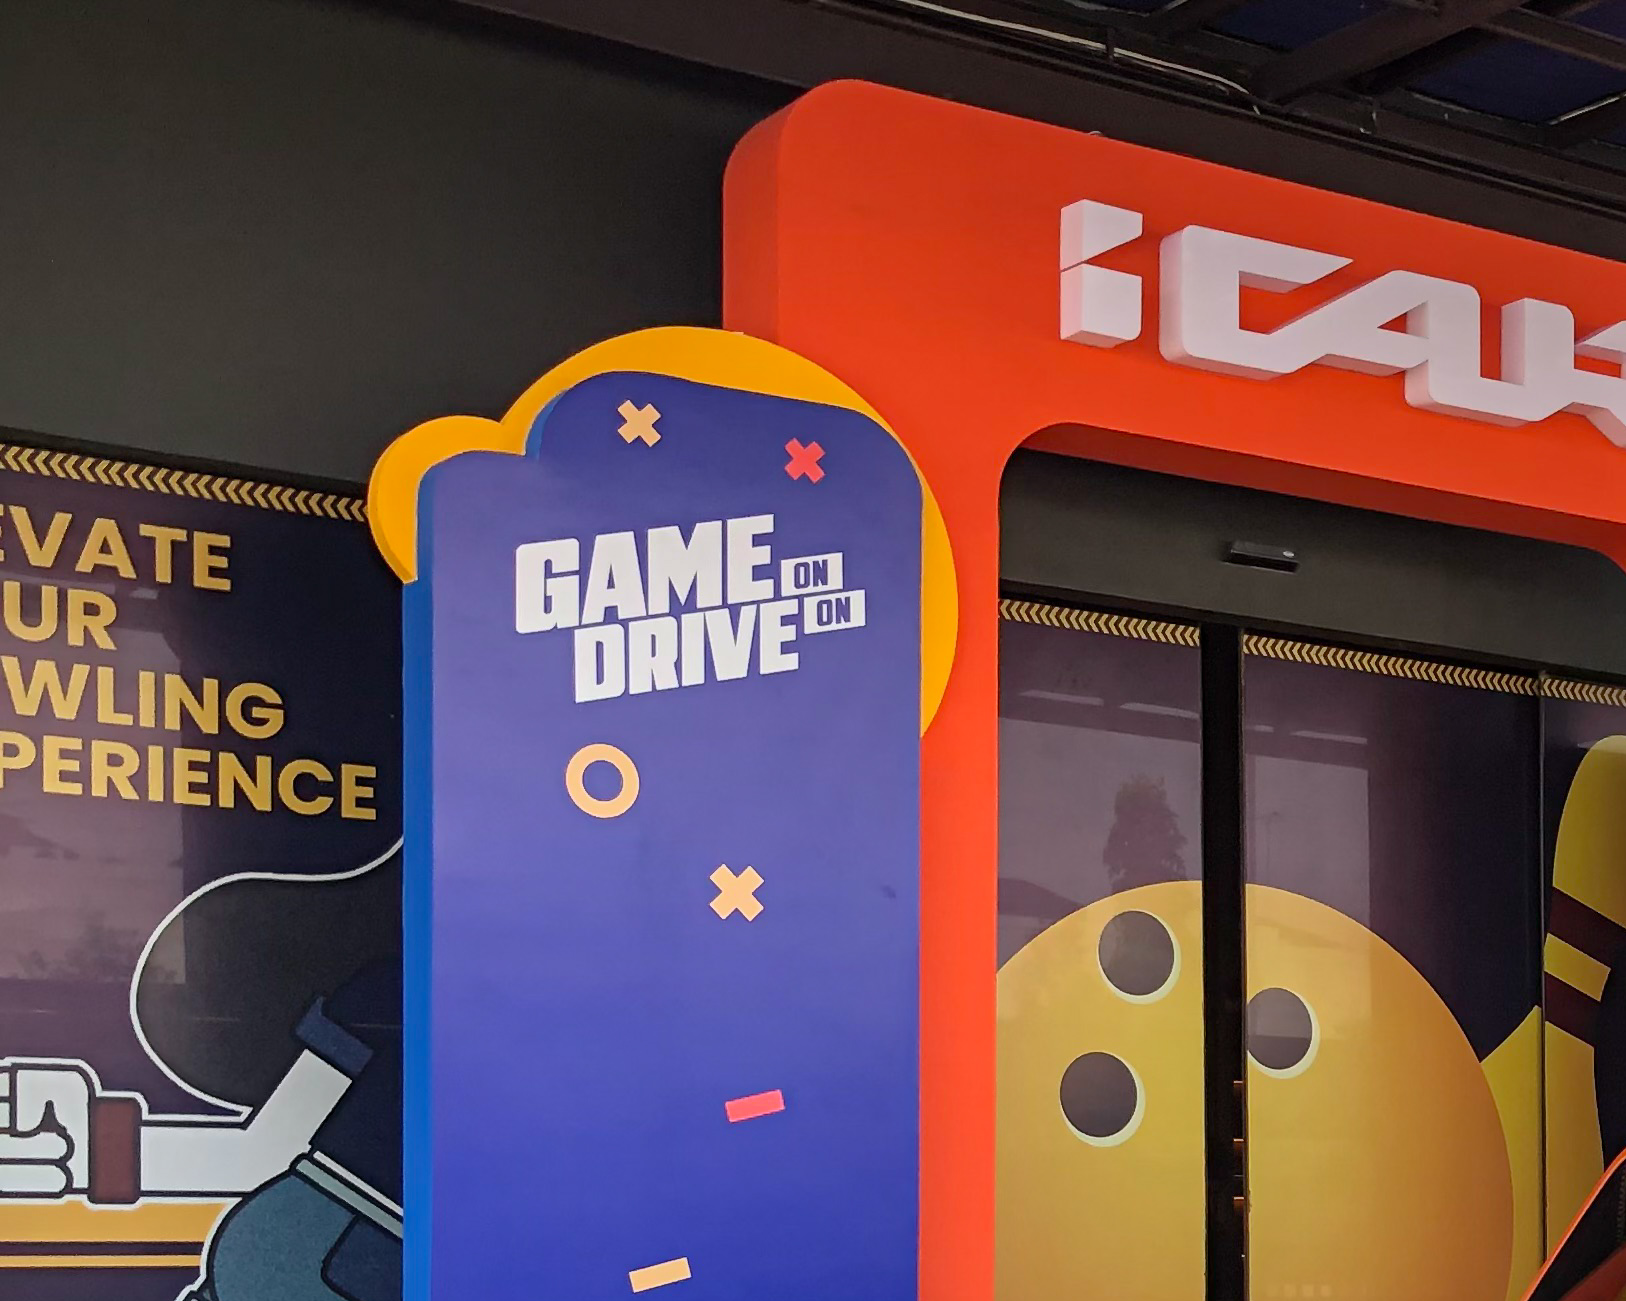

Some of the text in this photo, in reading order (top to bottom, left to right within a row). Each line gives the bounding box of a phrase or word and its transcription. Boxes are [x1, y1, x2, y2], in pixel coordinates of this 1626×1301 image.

[0, 504, 232, 592] VATE
[516, 513, 829, 634] GAME ON
[574, 597, 852, 703] DRIVE ON
[1, 656, 285, 739] WLING
[0, 731, 377, 821] PERIENCE
